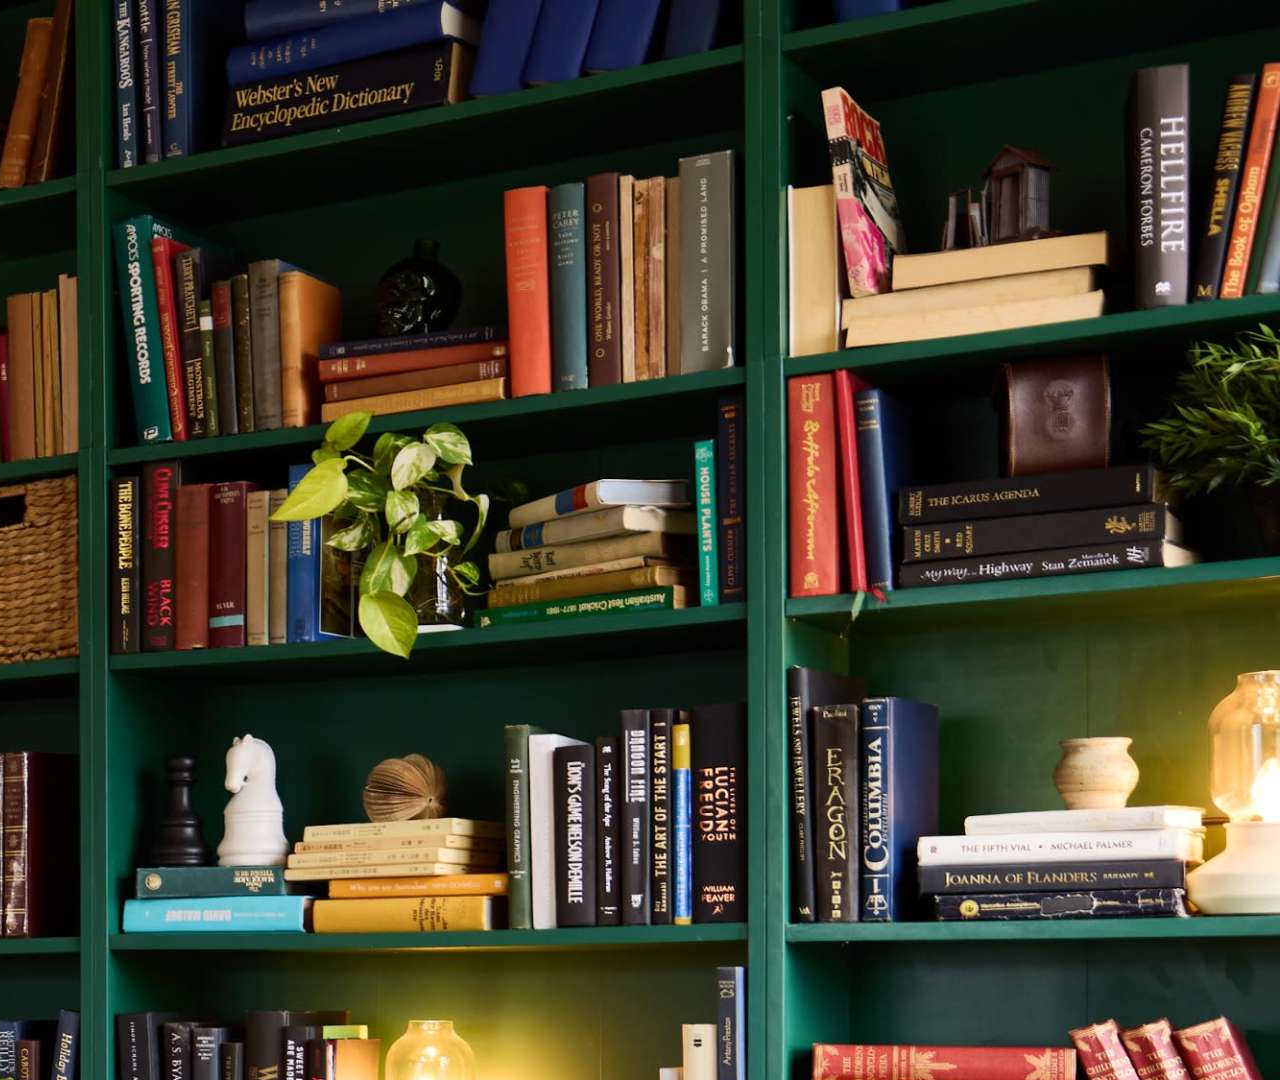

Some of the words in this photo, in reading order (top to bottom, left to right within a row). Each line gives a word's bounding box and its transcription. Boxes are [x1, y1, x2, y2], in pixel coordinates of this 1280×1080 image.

[167, 9, 181, 55] GRISHAM
[116, 17, 133, 89] KANGAROOS
[230, 97, 329, 132] Encyclopedic
[332, 81, 415, 113] Dictionary
[235, 77, 303, 108] Webster's
[304, 74, 339, 96] New
[1140, 127, 1154, 196] CAMERON
[700, 177, 708, 203] LAND
[1159, 116, 1186, 254] HELLFIRE
[1141, 196, 1154, 248] FORBES
[1208, 177, 1231, 237] SHELLA
[1239, 212, 1251, 232] of
[700, 206, 708, 255] PROMISED
[1229, 234, 1247, 270] Book
[127, 261, 146, 327] SPORTING
[701, 277, 709, 312] OBAMA
[1224, 272, 1239, 297] The
[134, 326, 152, 385] RECORDS
[195, 361, 203, 419] MONSTROUS
[118, 481, 133, 500] THE
[700, 467, 711, 504] HOUSE
[928, 496, 949, 507] THE
[950, 493, 990, 505] ICARUS
[993, 489, 1040, 502] AGENDA
[118, 522, 133, 570] PEOPLE
[701, 506, 713, 552] PLANTS
[913, 529, 921, 559] MARTIN
[978, 561, 1034, 578] Highway
[1041, 560, 1065, 572] Stan
[1067, 555, 1120, 569] Zemanek
[148, 581, 159, 627] WIND
[159, 579, 172, 626] BLACK
[629, 730, 646, 776] DRAGON
[654, 735, 667, 774] START
[629, 779, 646, 803] FIRE
[654, 777, 667, 801] THE
[700, 768, 713, 831] FREUD
[716, 767, 728, 831] LUCIAN
[825, 747, 847, 860] ERAGON
[863, 735, 889, 873] COLUMBIA
[655, 805, 667, 822] OF
[655, 824, 667, 849] ART
[702, 833, 736, 841] YOUTH
[981, 843, 1008, 853] FIFTH
[1009, 842, 1032, 852] VIAL
[1050, 840, 1092, 851] MICHAEL
[1093, 839, 1133, 850] PALMER
[568, 863, 584, 904] DEMILLE
[655, 853, 667, 877] THE
[944, 871, 1001, 888] JOANNA
[1004, 872, 1024, 884] OF
[1026, 870, 1098, 885] FLANDERS
[0, 1031, 9, 1073] REILLY
[21, 1048, 29, 1080] CABOT
[56, 1033, 72, 1073] Holiday
[296, 1046, 304, 1077] SWEET
